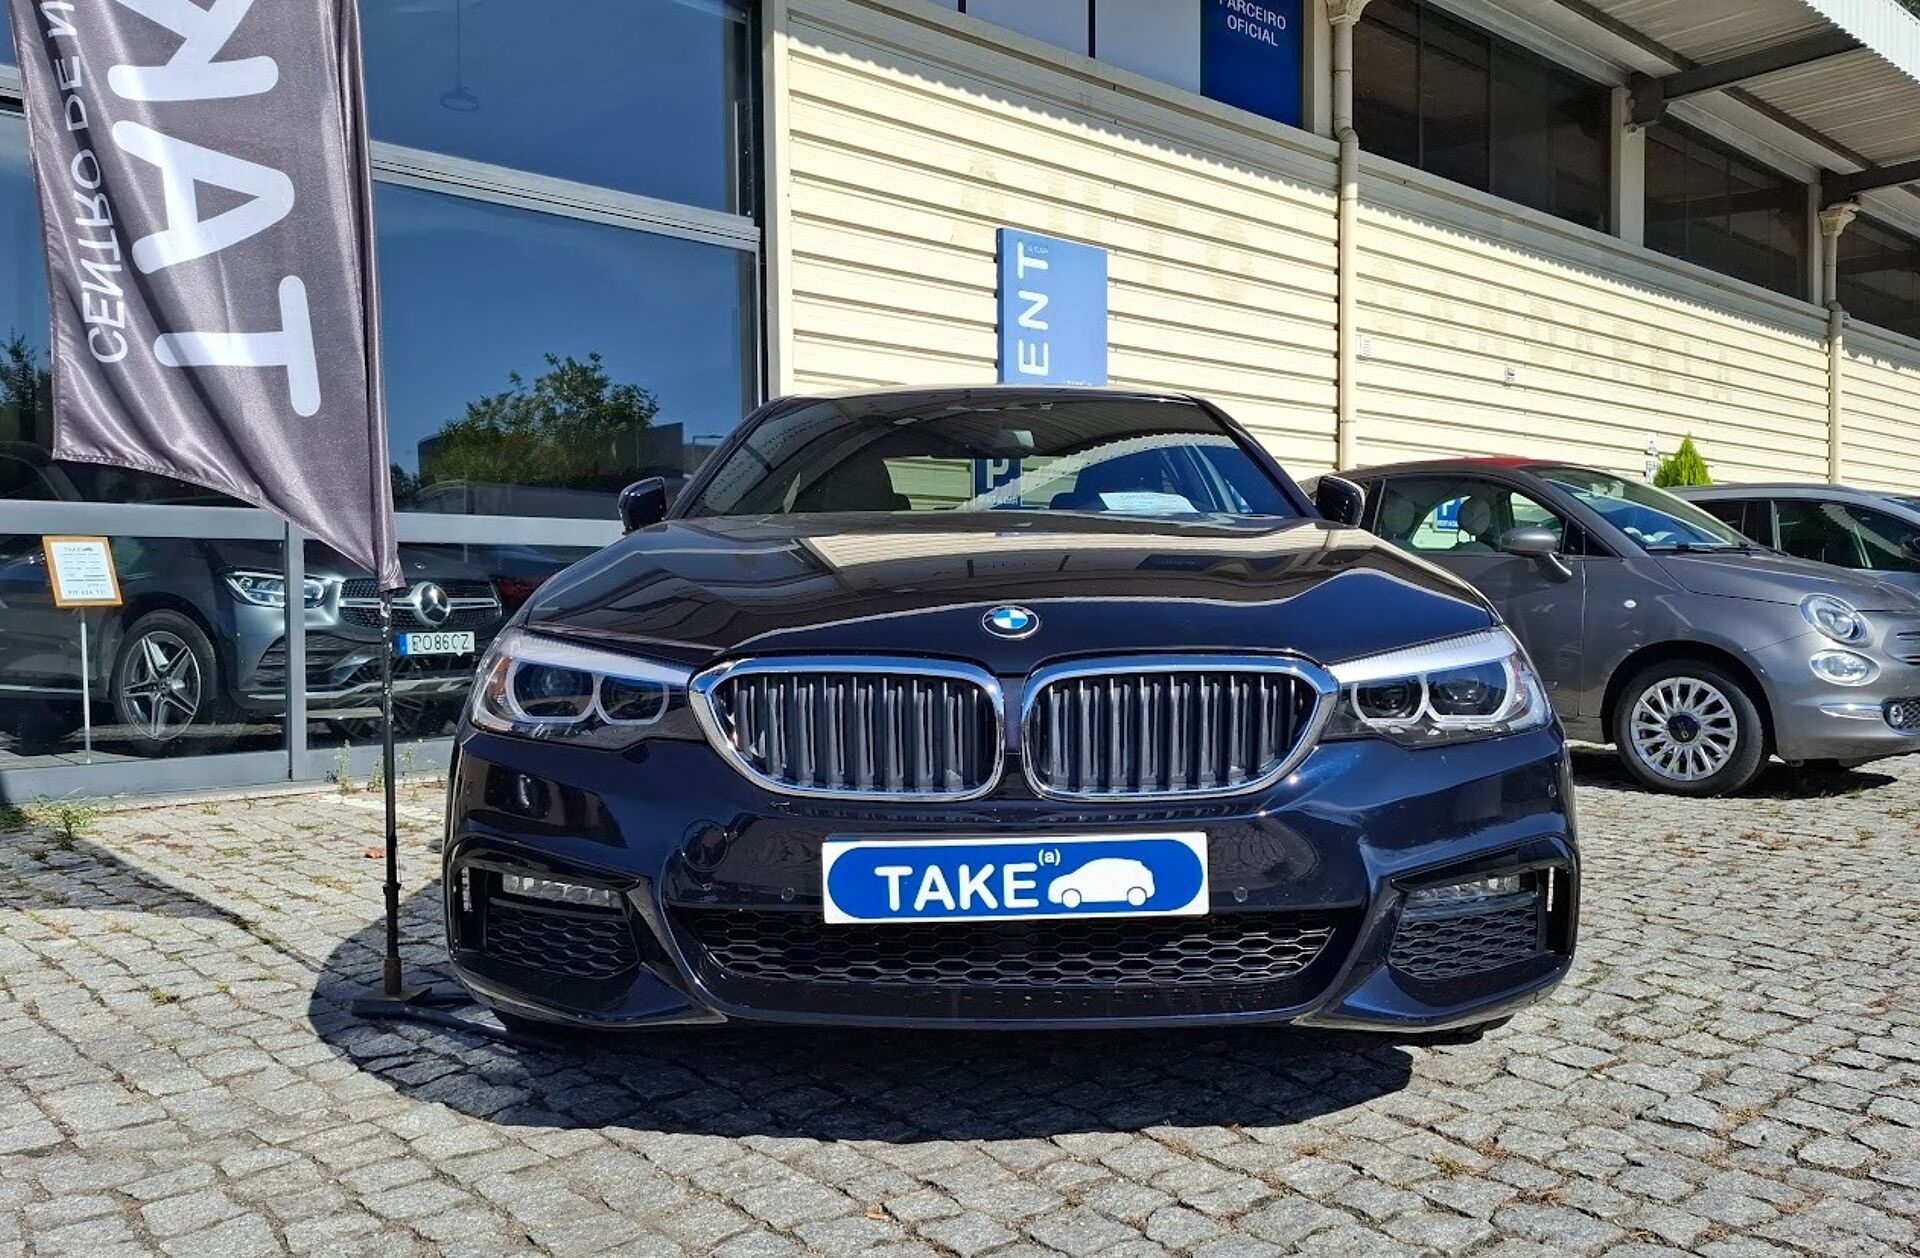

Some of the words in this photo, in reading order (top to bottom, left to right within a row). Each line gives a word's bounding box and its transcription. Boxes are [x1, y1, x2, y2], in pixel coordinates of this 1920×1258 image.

[1219, 0, 1286, 30] ARCEIRO
[1227, 14, 1279, 47] OFICIAL
[874, 862, 1040, 912] TAKE
